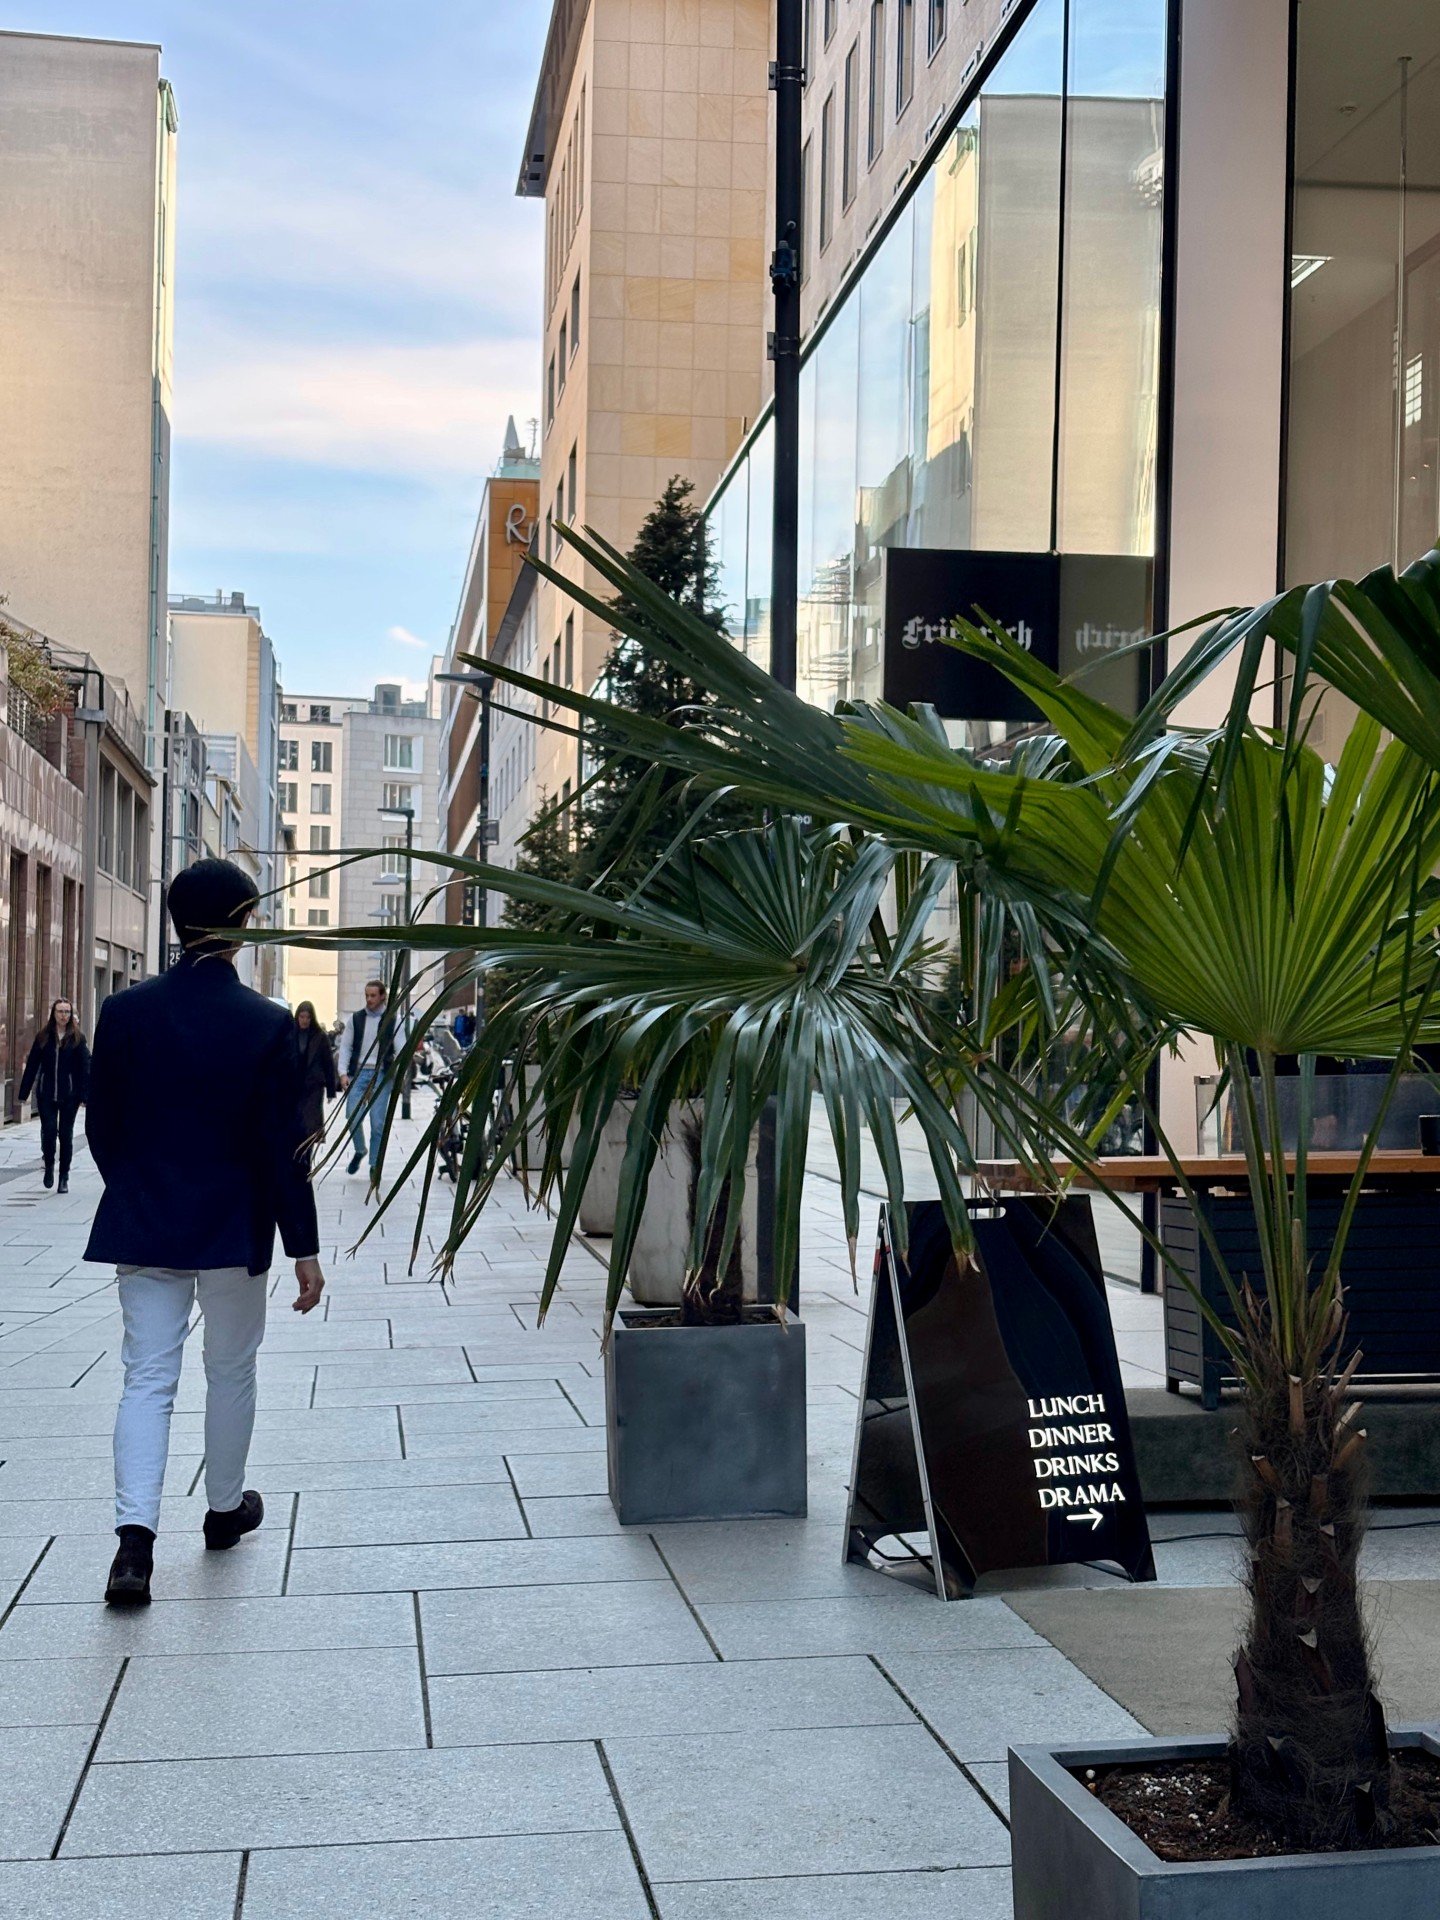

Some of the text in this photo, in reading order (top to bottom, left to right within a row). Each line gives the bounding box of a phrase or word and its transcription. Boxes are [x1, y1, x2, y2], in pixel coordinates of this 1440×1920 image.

[465, 886, 473, 919] TEL
[1027, 1393, 1106, 1418] LUNCH
[1028, 1423, 1115, 1448] DINNER
[1034, 1452, 1120, 1478] DRINKS
[1038, 1482, 1126, 1509] DRAMA
